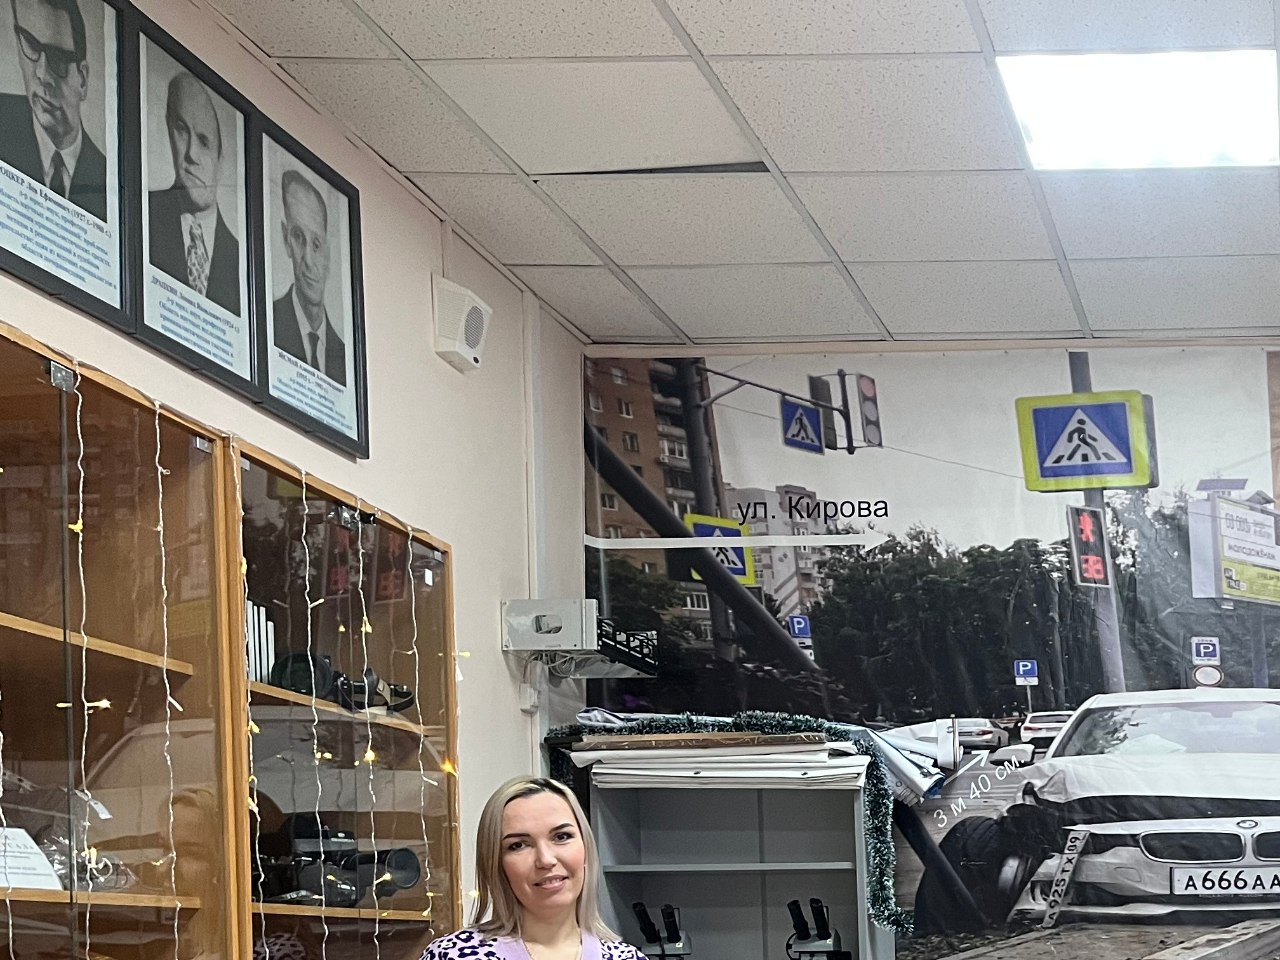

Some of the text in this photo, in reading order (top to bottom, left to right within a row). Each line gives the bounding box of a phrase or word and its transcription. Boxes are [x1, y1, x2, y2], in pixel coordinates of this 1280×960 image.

[737, 496, 889, 526] ул. Кирова
[933, 809, 948, 827] 3
[969, 774, 991, 799] 40
